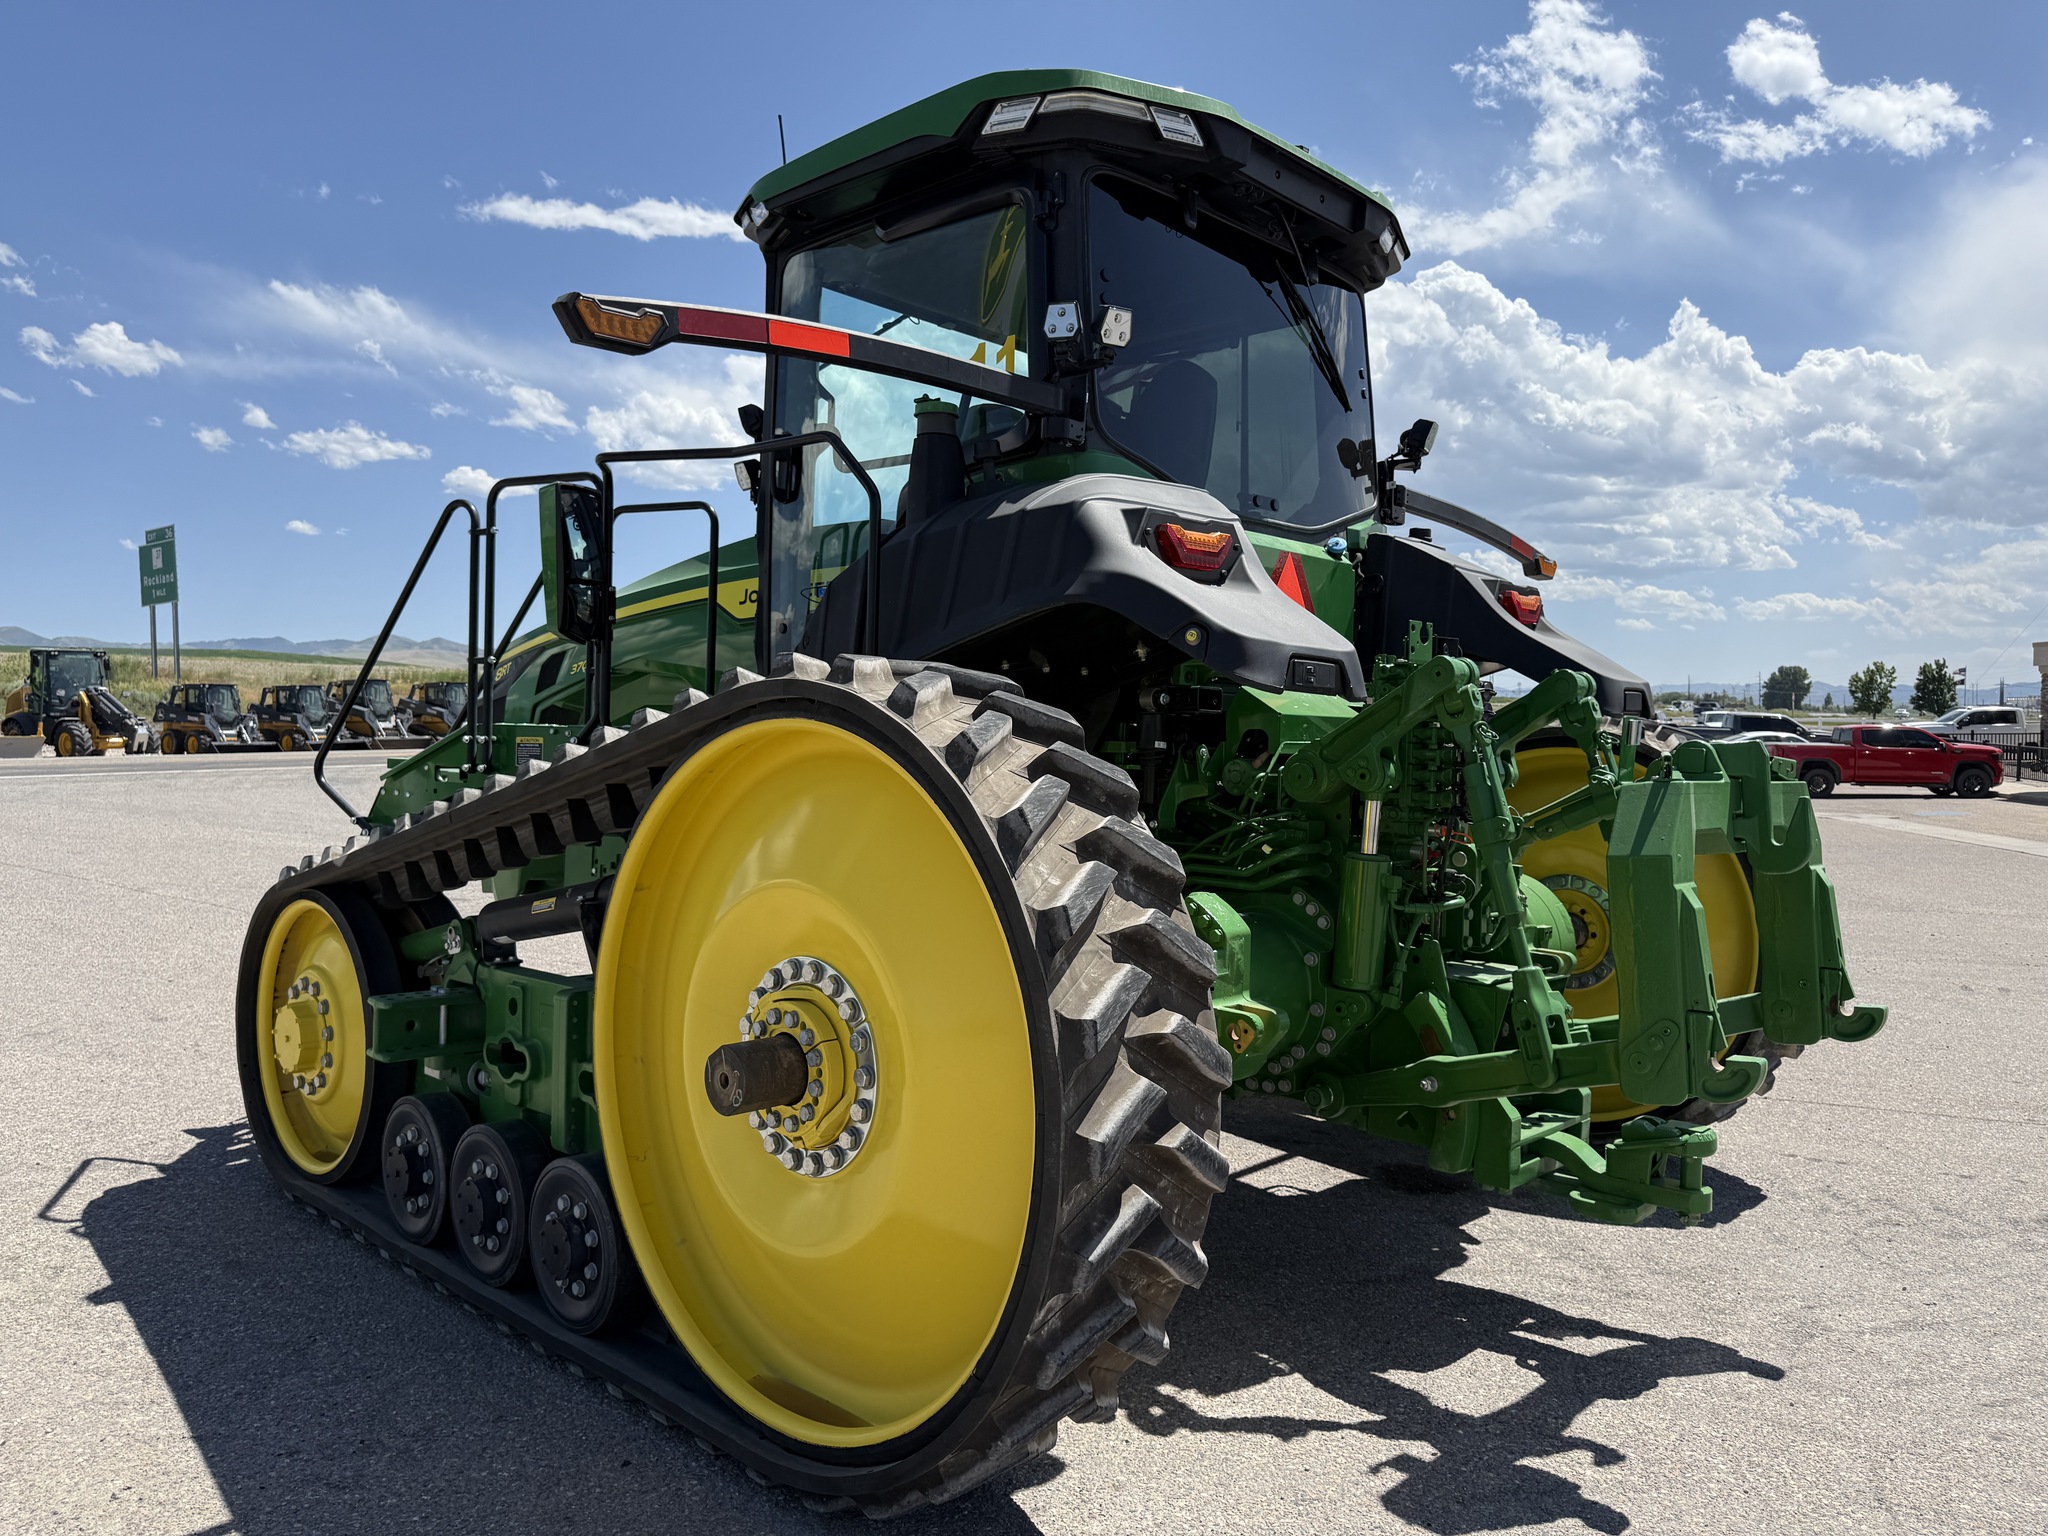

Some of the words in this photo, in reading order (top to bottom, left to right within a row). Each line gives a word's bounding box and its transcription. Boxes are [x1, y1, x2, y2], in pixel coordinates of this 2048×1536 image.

[147, 532, 157, 542] EXIT
[165, 528, 173, 539] 36
[143, 571, 175, 587] Rockland
[156, 588, 166, 597] MILE
[495, 661, 512, 681] 8RT
